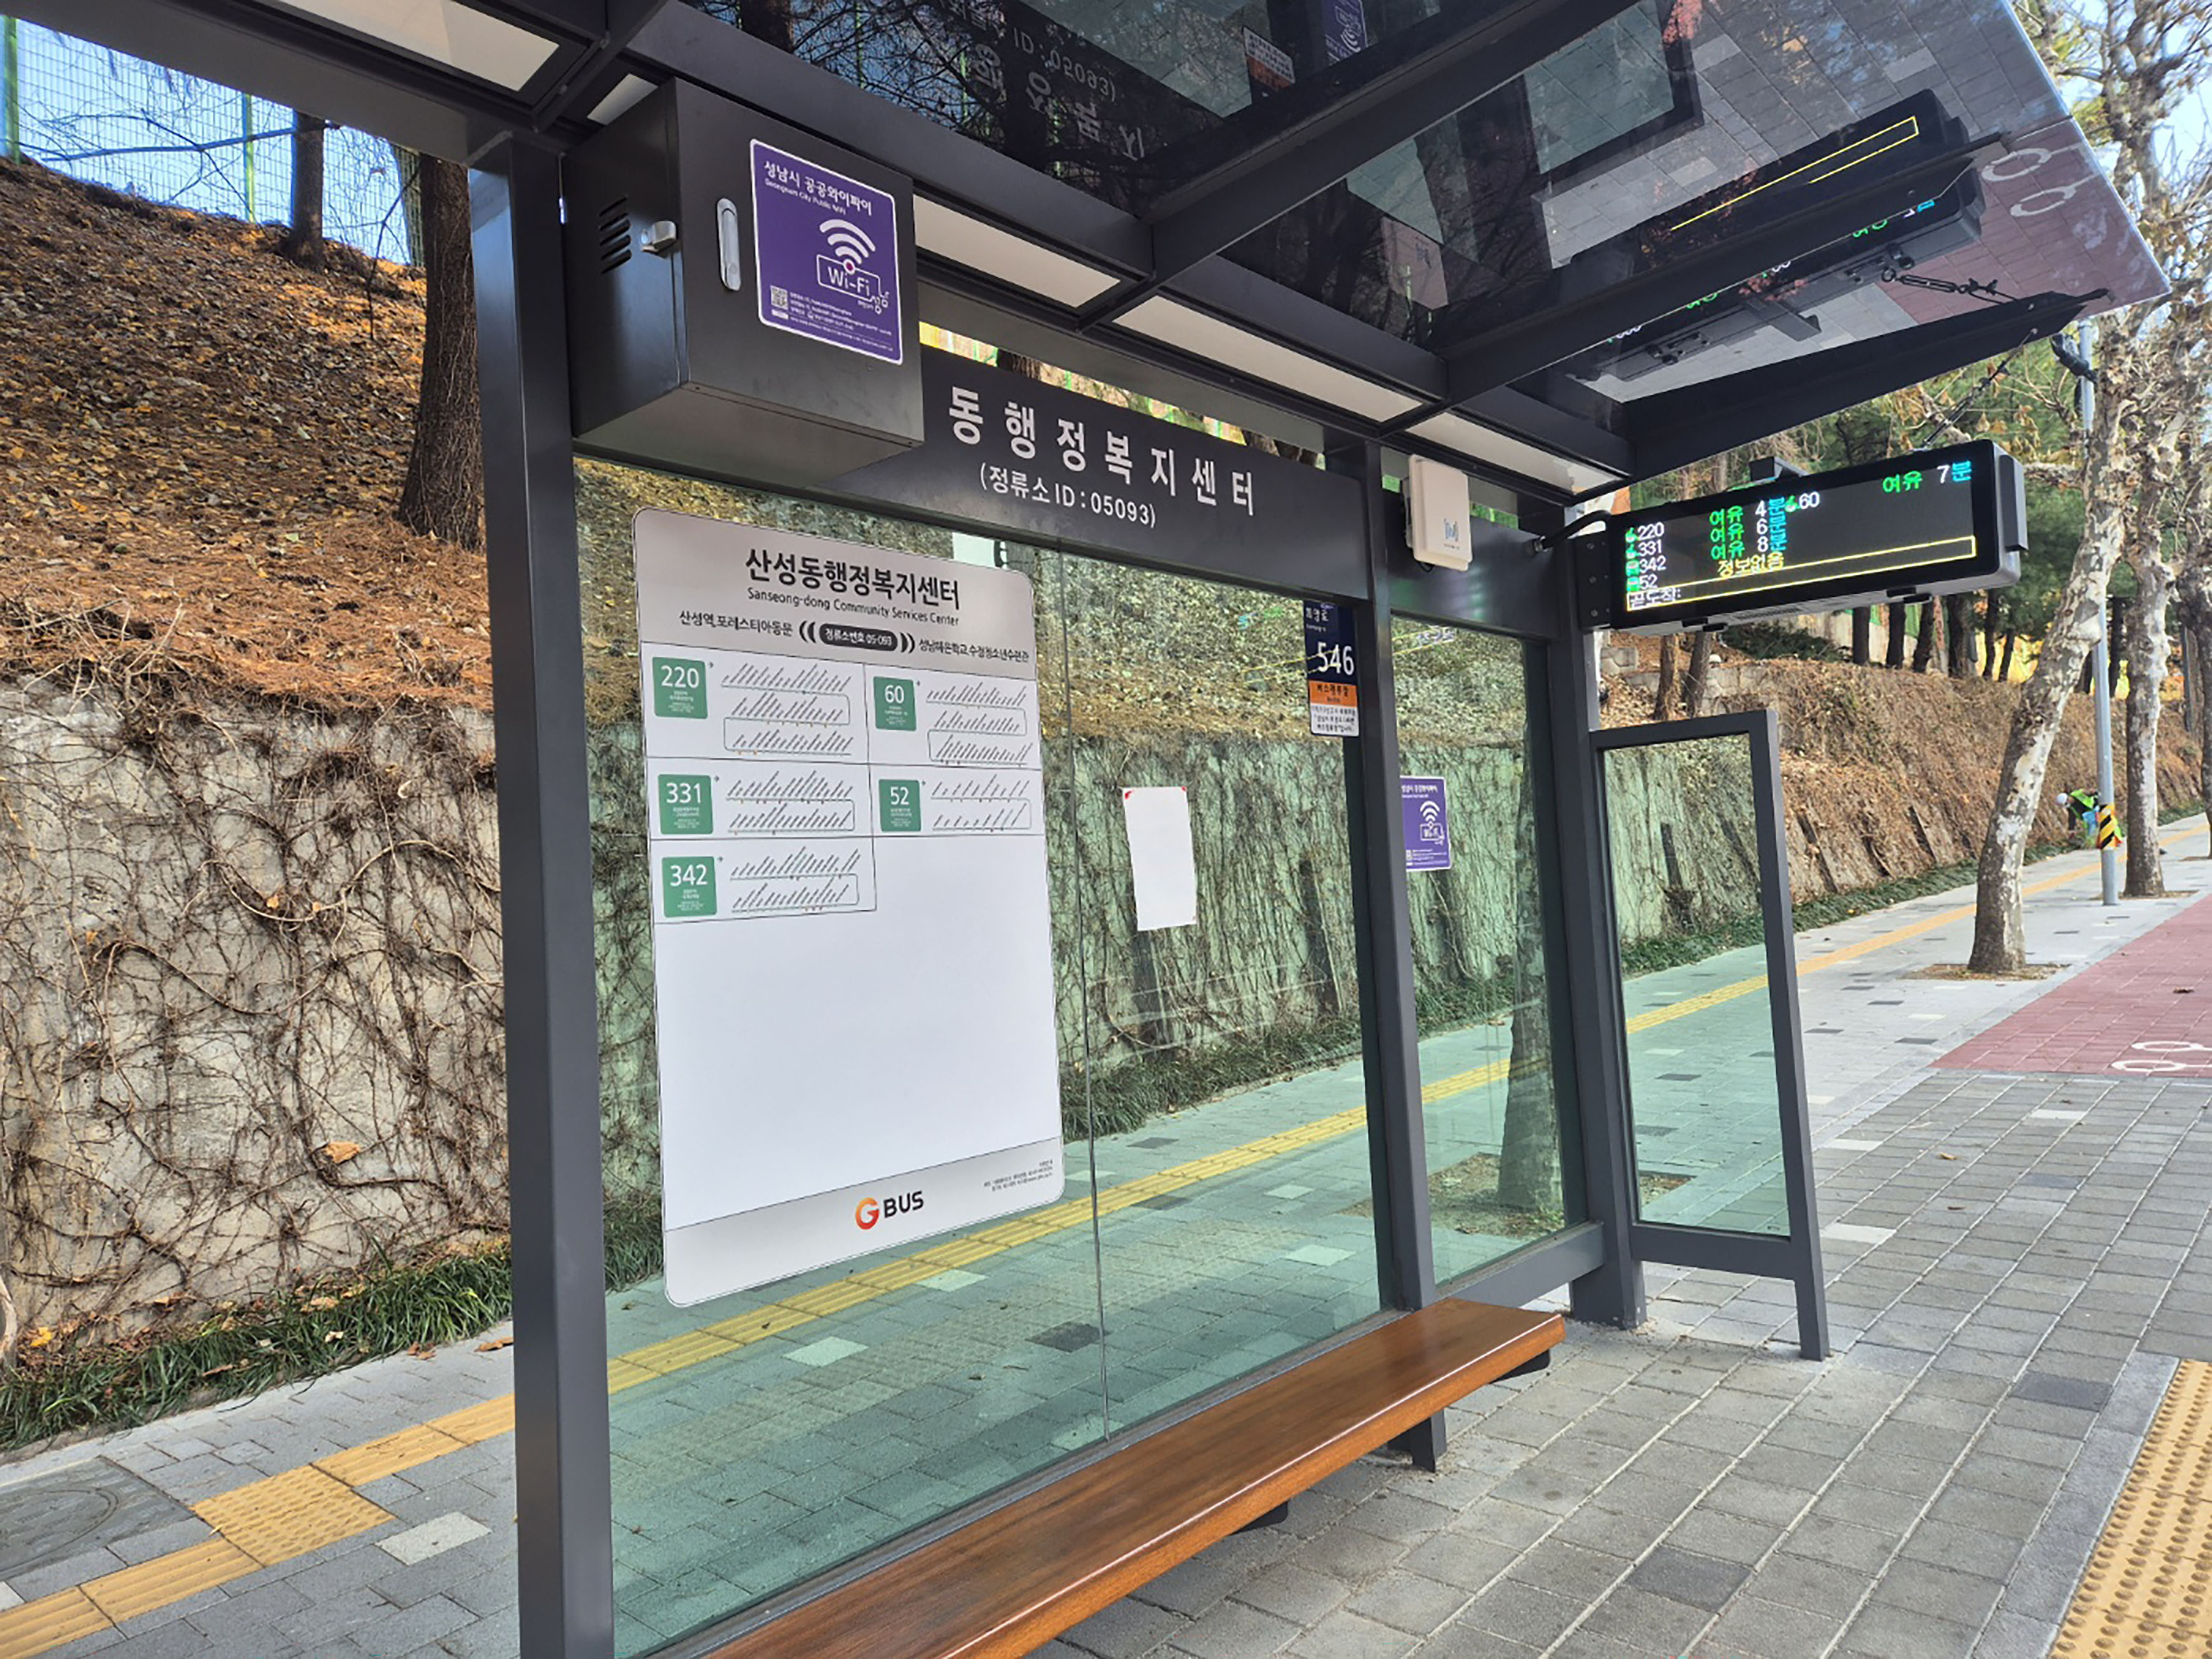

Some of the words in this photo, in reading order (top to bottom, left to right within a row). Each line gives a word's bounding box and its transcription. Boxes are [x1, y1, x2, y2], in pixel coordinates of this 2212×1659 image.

[764, 160, 800, 187] 성남시
[804, 176, 872, 216] 공공와이파이
[828, 267, 870, 297] Wi-Fi
[1799, 491, 1820, 510] 60
[1882, 471, 1922, 493] 여유
[1638, 522, 1664, 540] 220
[1709, 505, 1743, 525] 여유
[1638, 540, 1662, 556] 331
[1710, 523, 1744, 543] 여유
[1639, 556, 1666, 573] 342
[1711, 540, 1745, 560] 여유
[1639, 574, 1658, 589] 52
[1718, 551, 1784, 578] 정보없음
[745, 548, 960, 610] 산성동행정복지센터
[747, 587, 830, 611] Sanseong-dong
[833, 599, 890, 618] Community
[892, 607, 928, 623] Services
[930, 613, 959, 626] Center
[1317, 641, 1355, 676] 546
[661, 665, 699, 688] 220
[885, 684, 904, 704] 60
[666, 782, 701, 804] 331
[890, 787, 909, 805] 52
[670, 864, 707, 887] 342
